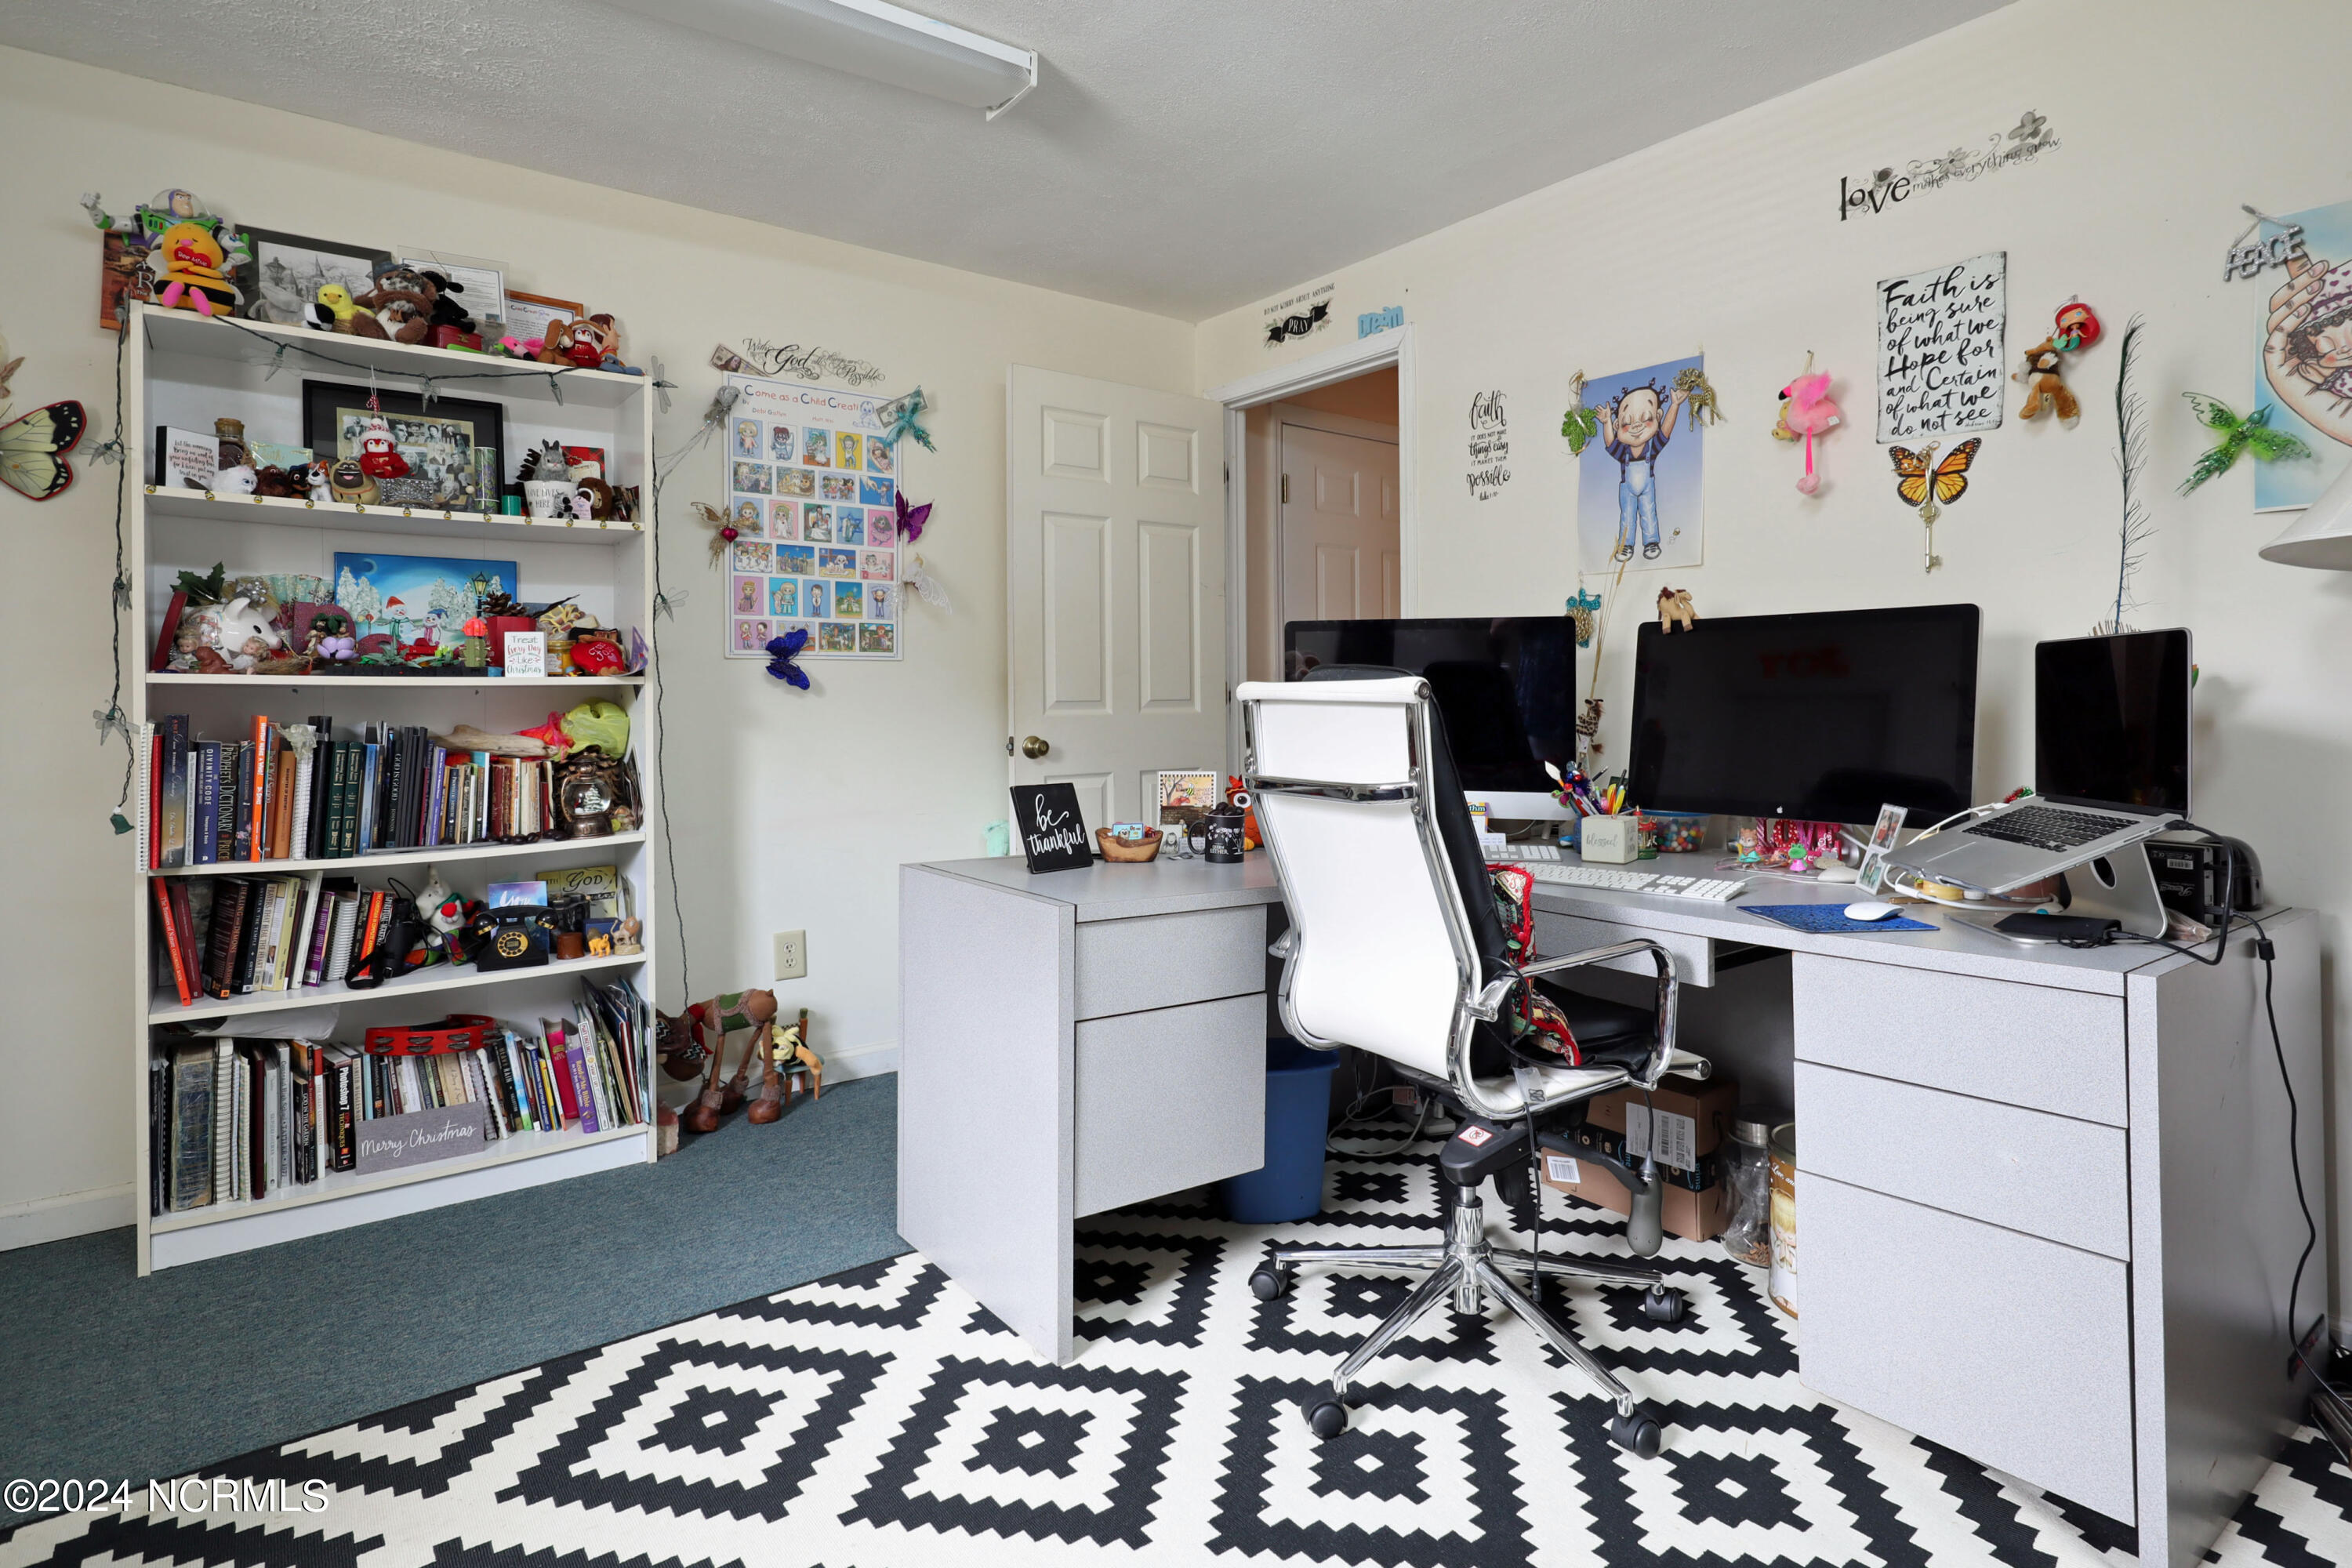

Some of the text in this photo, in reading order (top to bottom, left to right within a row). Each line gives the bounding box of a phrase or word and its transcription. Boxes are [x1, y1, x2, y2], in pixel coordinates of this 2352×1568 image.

[1840, 176, 1911, 222] love
[1913, 171, 1951, 193] makes
[1953, 150, 2023, 182] everything
[2223, 225, 2305, 283] PEACE
[1882, 265, 1999, 314] Faith is
[1288, 318, 1309, 333] PRAY
[1886, 296, 1995, 333] being sure
[1886, 318, 2000, 355] of what we
[763, 344, 821, 380] God
[1884, 338, 1994, 381] Hope for
[744, 384, 777, 400] Come
[779, 393, 789, 401] as
[800, 393, 826, 407] Child
[1886, 365, 1998, 397] and Certain
[1468, 390, 1507, 430] faith
[1886, 385, 1998, 420] of what we
[1891, 408, 1993, 436] do not see
[1468, 440, 1508, 459] things easy
[1466, 464, 1512, 496] possible
[507, 644, 541, 656] Every Day
[510, 635, 538, 644] Treat
[506, 664, 543, 674] Christmas
[204, 749, 214, 806] DIVINITY CODE
[391, 779, 401, 801] GOOD
[218, 747, 237, 861] PROPHET'S DICTIONARY PRICE
[1035, 793, 1069, 832] be
[1027, 822, 1087, 856] thankful
[1585, 833, 1619, 847] blessed
[236, 887, 248, 916] DEALING
[380, 896, 394, 922] SPIRITUAL
[230, 926, 241, 953] DEMONS
[256, 887, 277, 969] PRAYERS THAT HEAL THE HEART
[499, 1047, 508, 1067] HEAVY
[575, 1060, 584, 1075] Read
[339, 1066, 350, 1105] Photoshop
[503, 1068, 513, 1083] RAIN
[580, 1080, 587, 1090] Me
[582, 1091, 590, 1108] Bible
[361, 1120, 477, 1158] Merry Christmas
